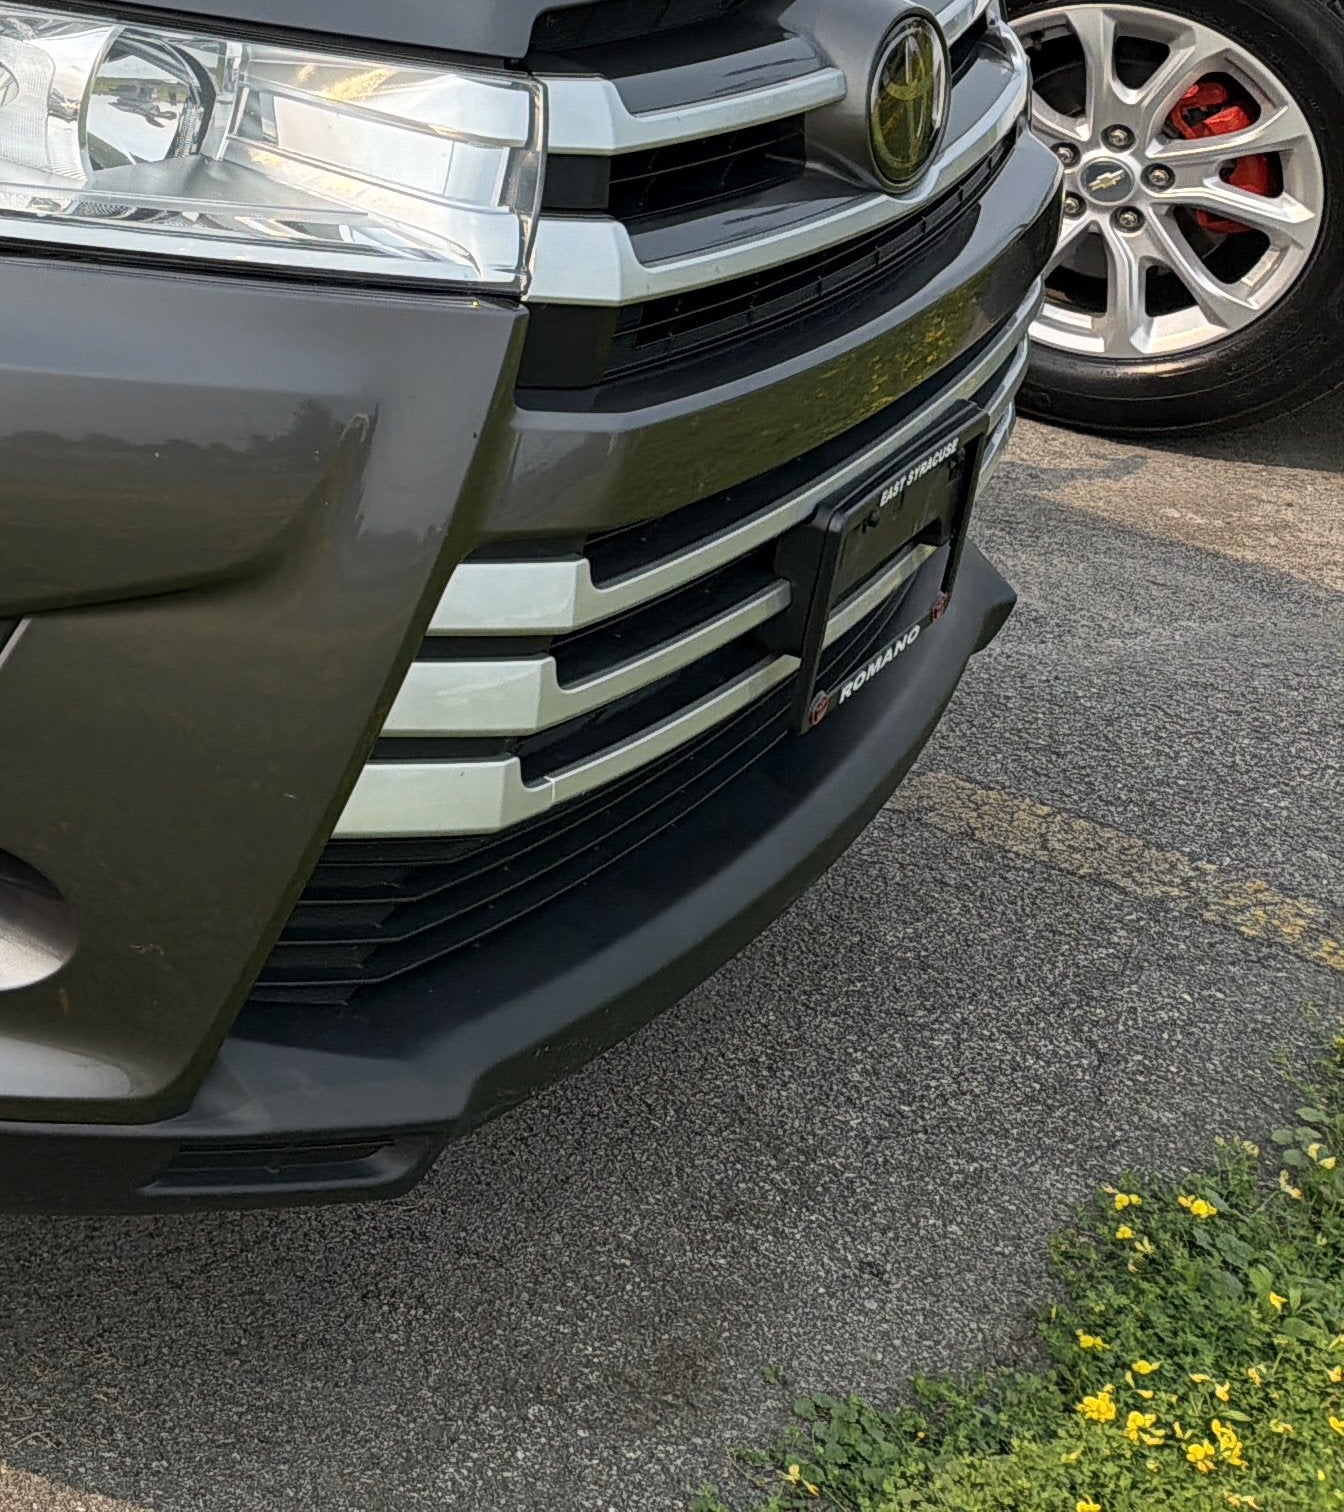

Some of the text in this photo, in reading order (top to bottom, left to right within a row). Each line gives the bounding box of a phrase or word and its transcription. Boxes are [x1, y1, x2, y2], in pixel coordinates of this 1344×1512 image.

[880, 438, 959, 507] EAST SYRACUSE
[839, 624, 921, 703] ROMANO
